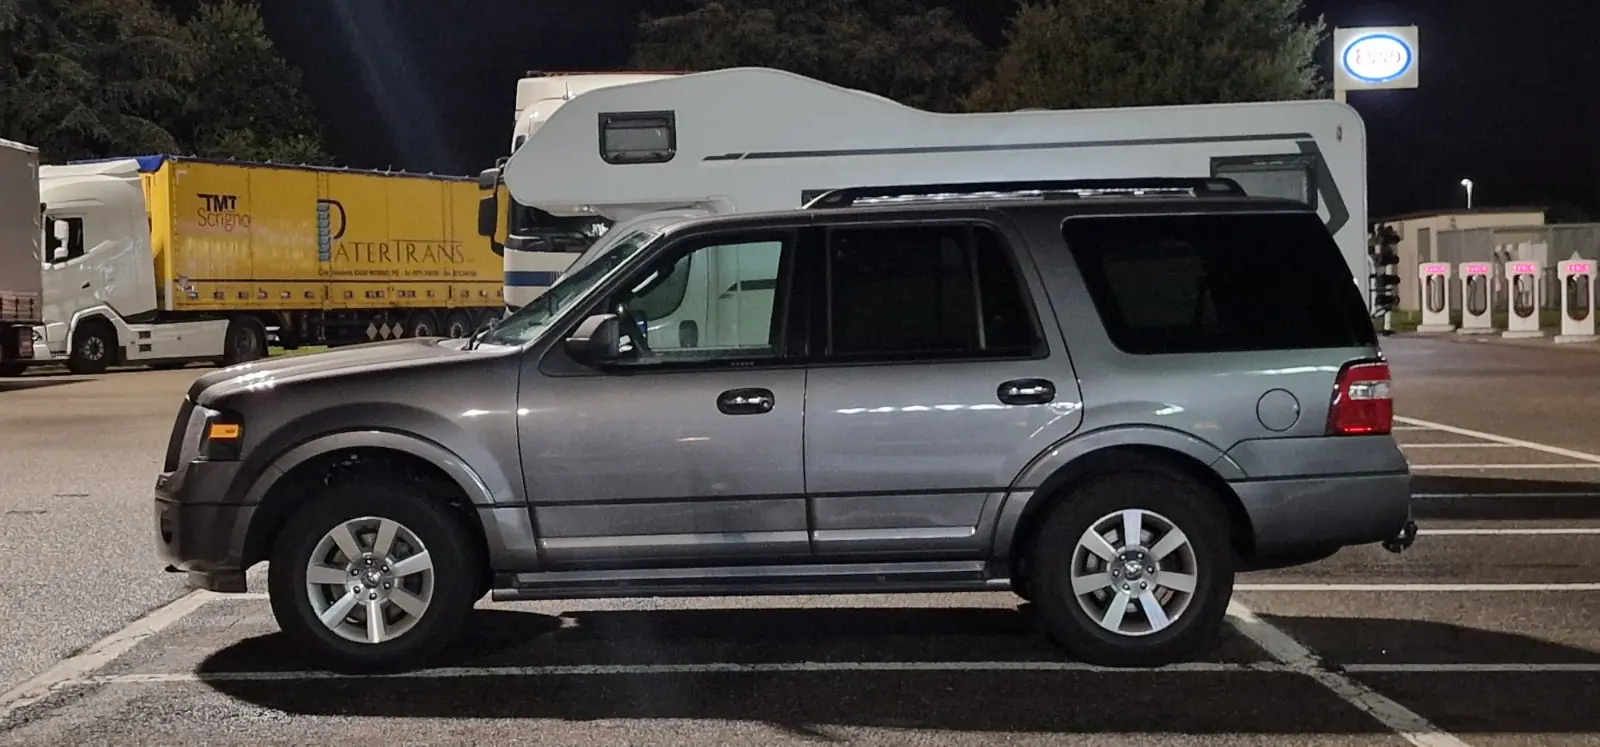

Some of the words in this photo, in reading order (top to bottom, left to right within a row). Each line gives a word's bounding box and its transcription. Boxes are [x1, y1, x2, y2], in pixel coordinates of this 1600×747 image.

[1356, 48, 1401, 65] Eo
[196, 193, 237, 212] TMT
[197, 207, 251, 233] Scrigno
